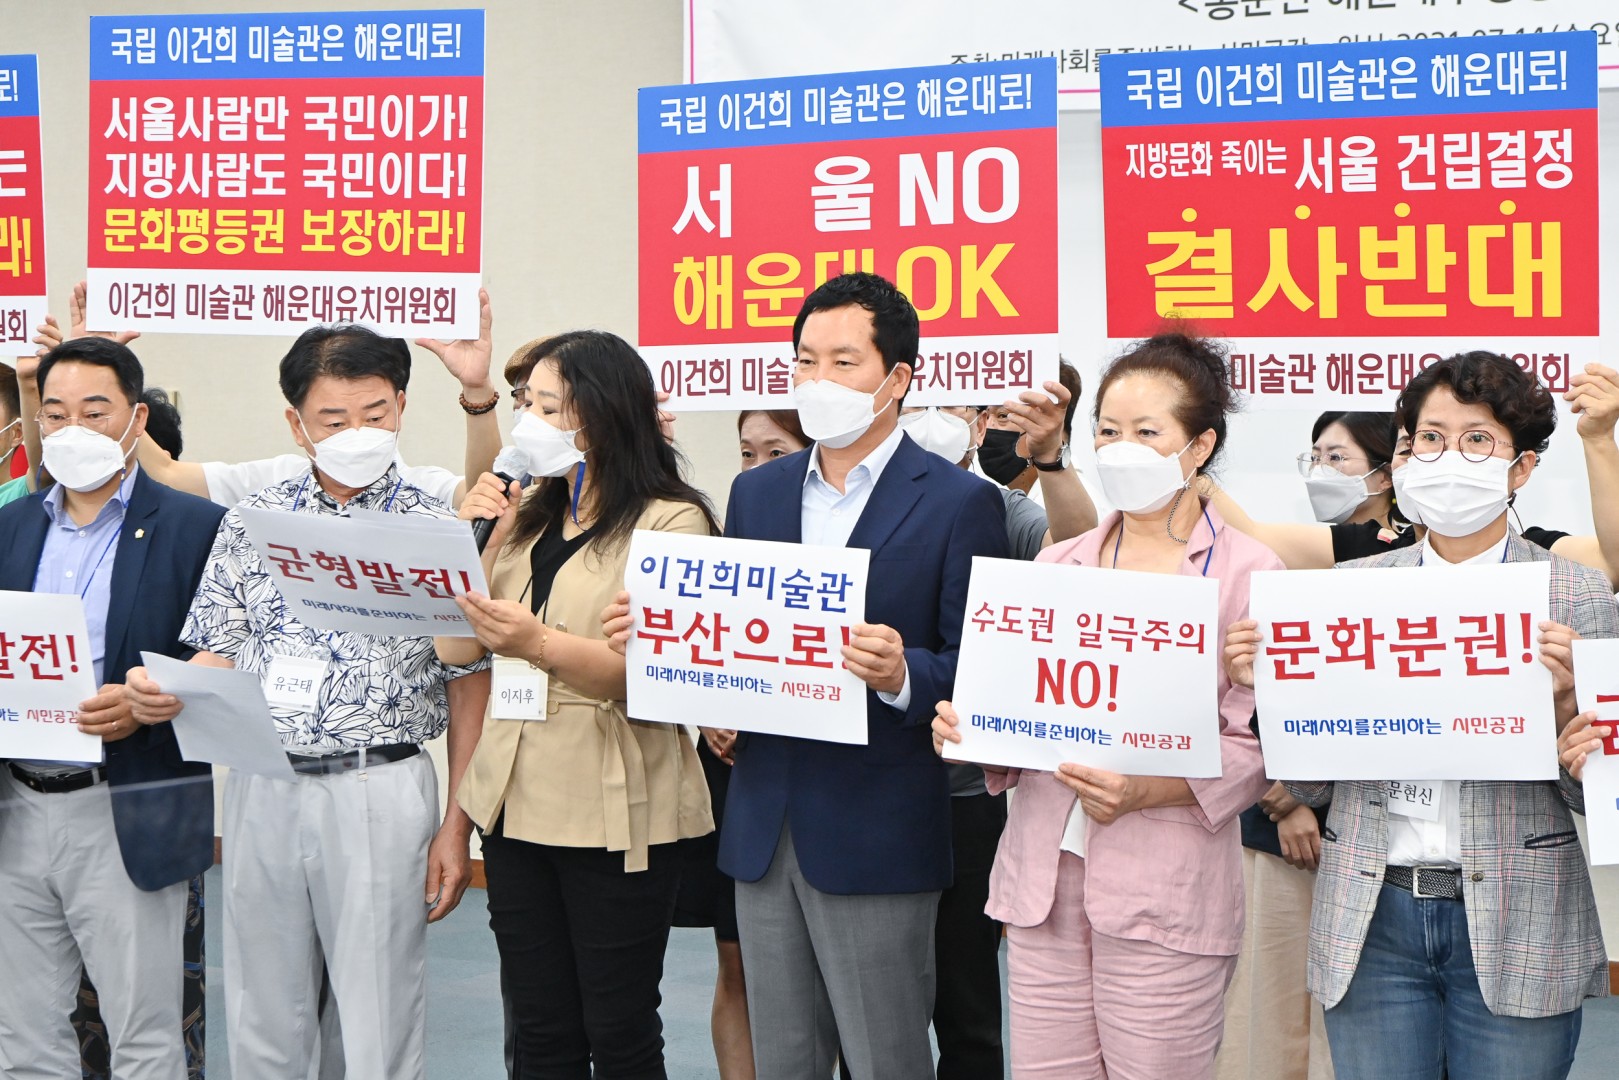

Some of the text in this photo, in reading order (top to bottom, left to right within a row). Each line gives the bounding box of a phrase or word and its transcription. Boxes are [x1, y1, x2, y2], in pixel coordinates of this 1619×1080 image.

[111, 23, 462, 64] 국립 이건희 미술관은 해운대로!
[1126, 50, 1568, 110] 국립 이건희 미술관은 해운대로!
[104, 94, 468, 141] 서울사람만 국민이가!
[660, 74, 1032, 135] 국립 이건희 미술관은 해운대로!
[104, 152, 467, 198] 지방사람도 국민이다!
[1126, 129, 1573, 194] 지방문화 죽이는 서울 건립결정
[104, 208, 464, 256] 문화평등권 보장하라!
[1145, 221, 1562, 318] 결사반대
[108, 282, 456, 325] 이건희 미술관 해운대유치위원회
[661, 358, 730, 397] 이건희
[742, 357, 798, 395] 미술
[1230, 354, 1314, 394] 미술관
[267, 543, 472, 600] 균형발전!
[640, 556, 853, 613] 이건희미술관
[301, 599, 427, 622] 미래사회를준비하는
[972, 601, 1205, 654] 수도권 일극주의
[637, 606, 852, 670] 부산으로!
[1266, 613, 1533, 680] 문화분권!
[274, 676, 312, 694] 유근태
[501, 688, 534, 704] 이지후
[646, 665, 842, 701] 미래사회를준비하는 시민공감
[1035, 658, 1119, 712] NO!
[971, 715, 1192, 750] 미래사회를준비하는 시민공감
[1284, 717, 1525, 736] 미래사회를준비하는 시민공감
[1387, 780, 1432, 806] 문현신
